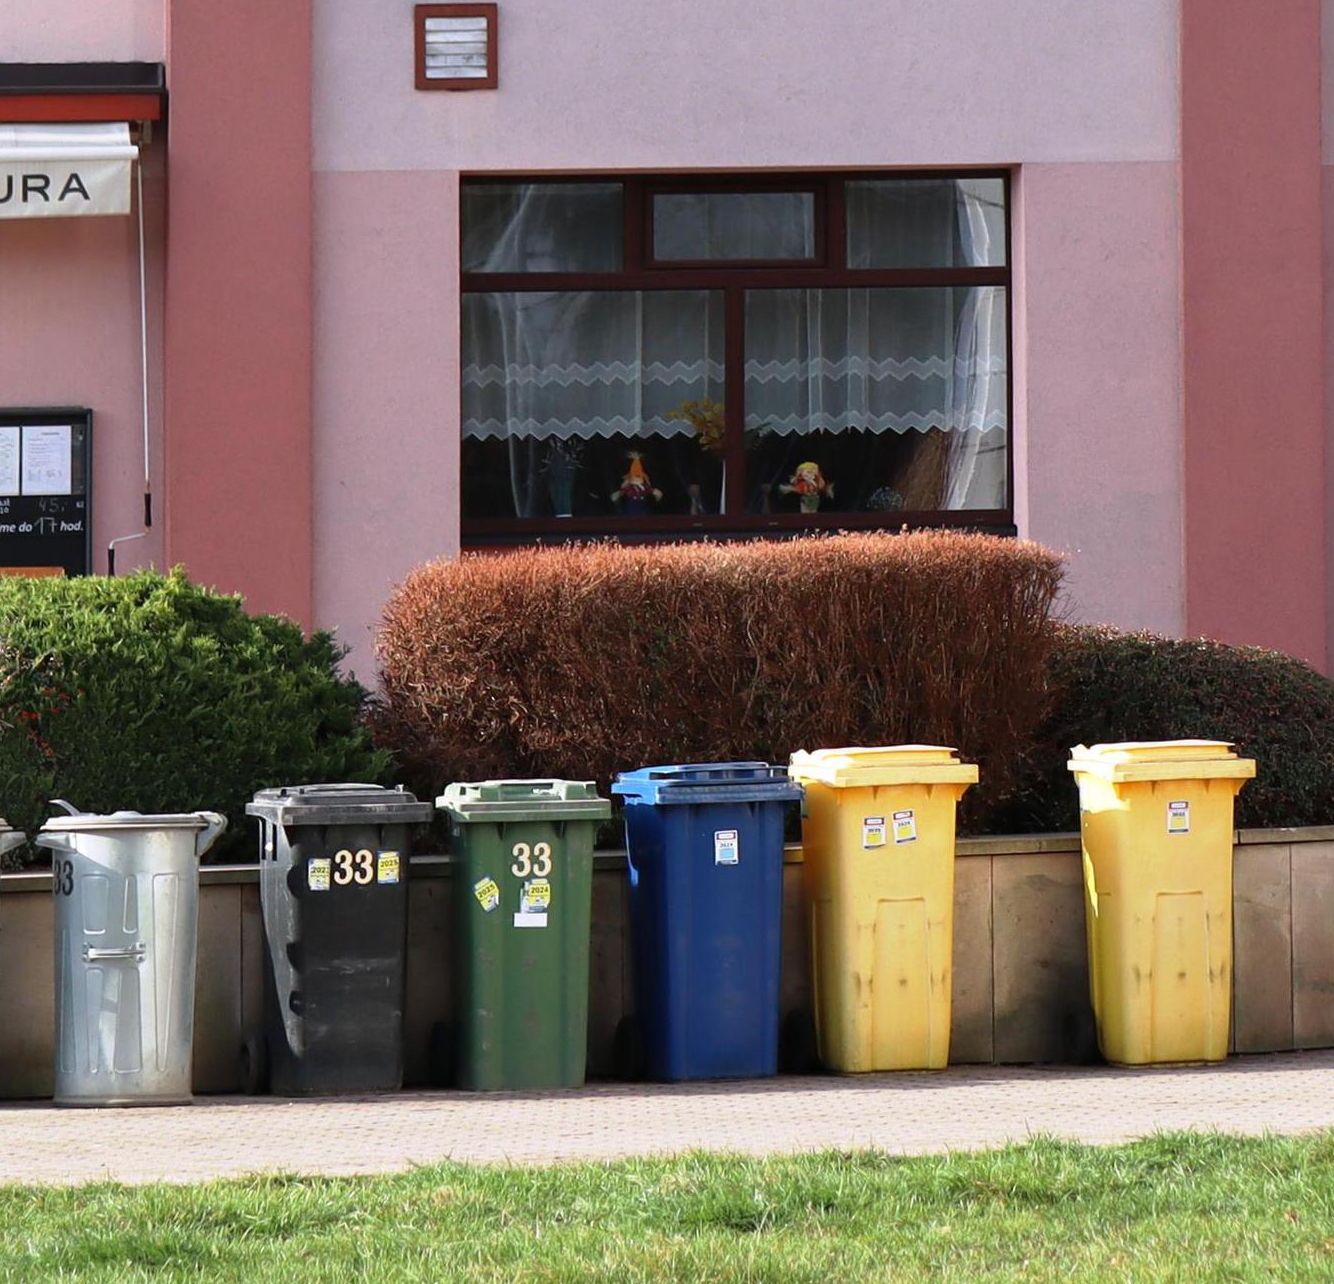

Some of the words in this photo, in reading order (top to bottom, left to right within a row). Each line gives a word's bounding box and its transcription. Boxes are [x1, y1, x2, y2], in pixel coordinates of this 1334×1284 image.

[18, 521, 33, 533] do
[34, 516, 58, 535] 17
[60, 520, 84, 532] hod.
[333, 849, 374, 885] 33
[511, 842, 552, 877] 33
[530, 886, 549, 894] 2024
